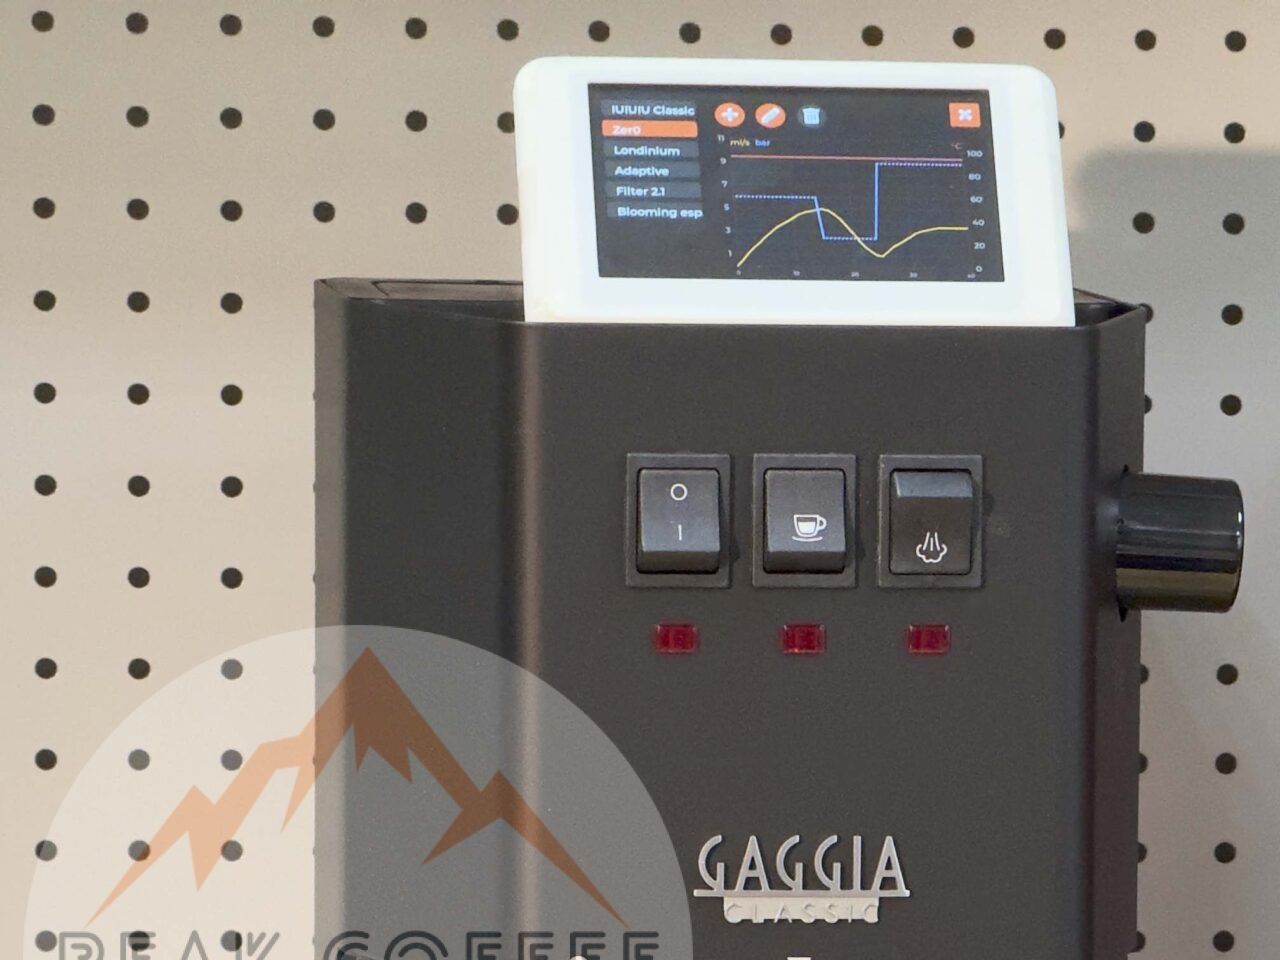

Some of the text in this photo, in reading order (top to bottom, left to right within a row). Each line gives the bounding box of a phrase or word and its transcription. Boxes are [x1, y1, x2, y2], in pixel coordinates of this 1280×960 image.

[653, 105, 695, 116] Classic
[614, 145, 680, 156] Londinium
[614, 166, 670, 177] Adaptive
[968, 173, 981, 181] 80
[616, 186, 665, 197] Filter 2.1
[617, 207, 677, 219] Blooming
[697, 834, 909, 897] GAGGIA
[725, 903, 879, 924] CLASSIC
